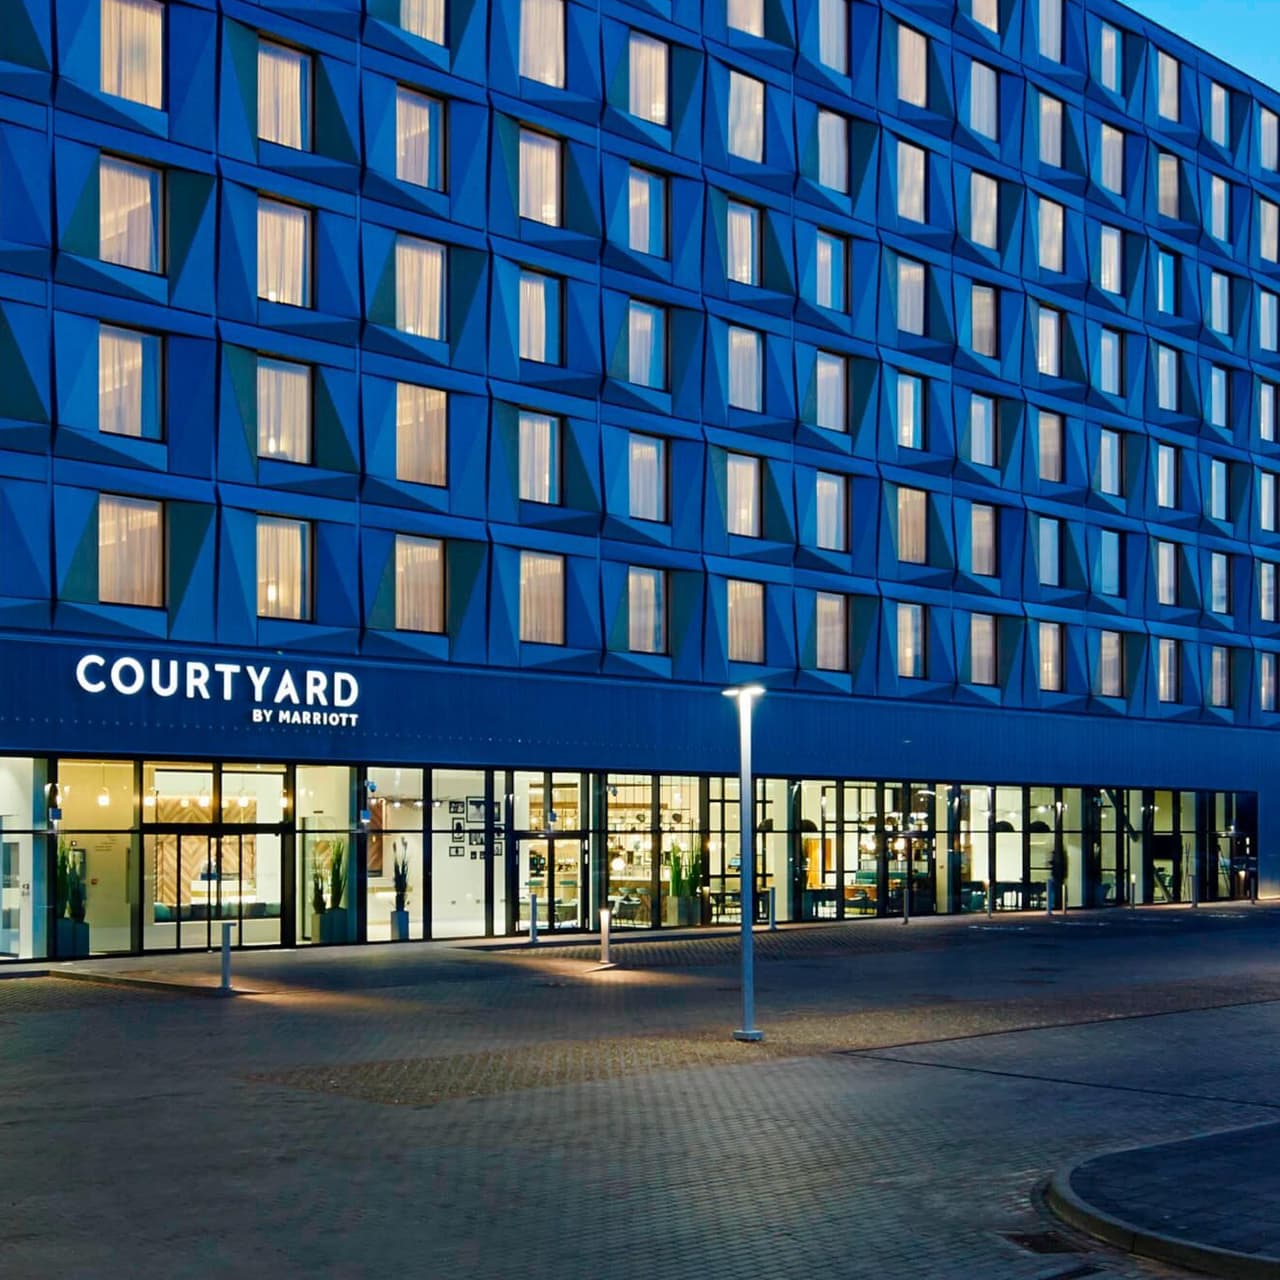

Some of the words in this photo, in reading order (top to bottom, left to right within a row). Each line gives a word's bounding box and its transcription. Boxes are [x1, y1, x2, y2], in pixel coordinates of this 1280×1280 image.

[75, 654, 359, 708] COURTYARD
[252, 708, 273, 723] BY
[278, 710, 359, 727] MARRIOTT
